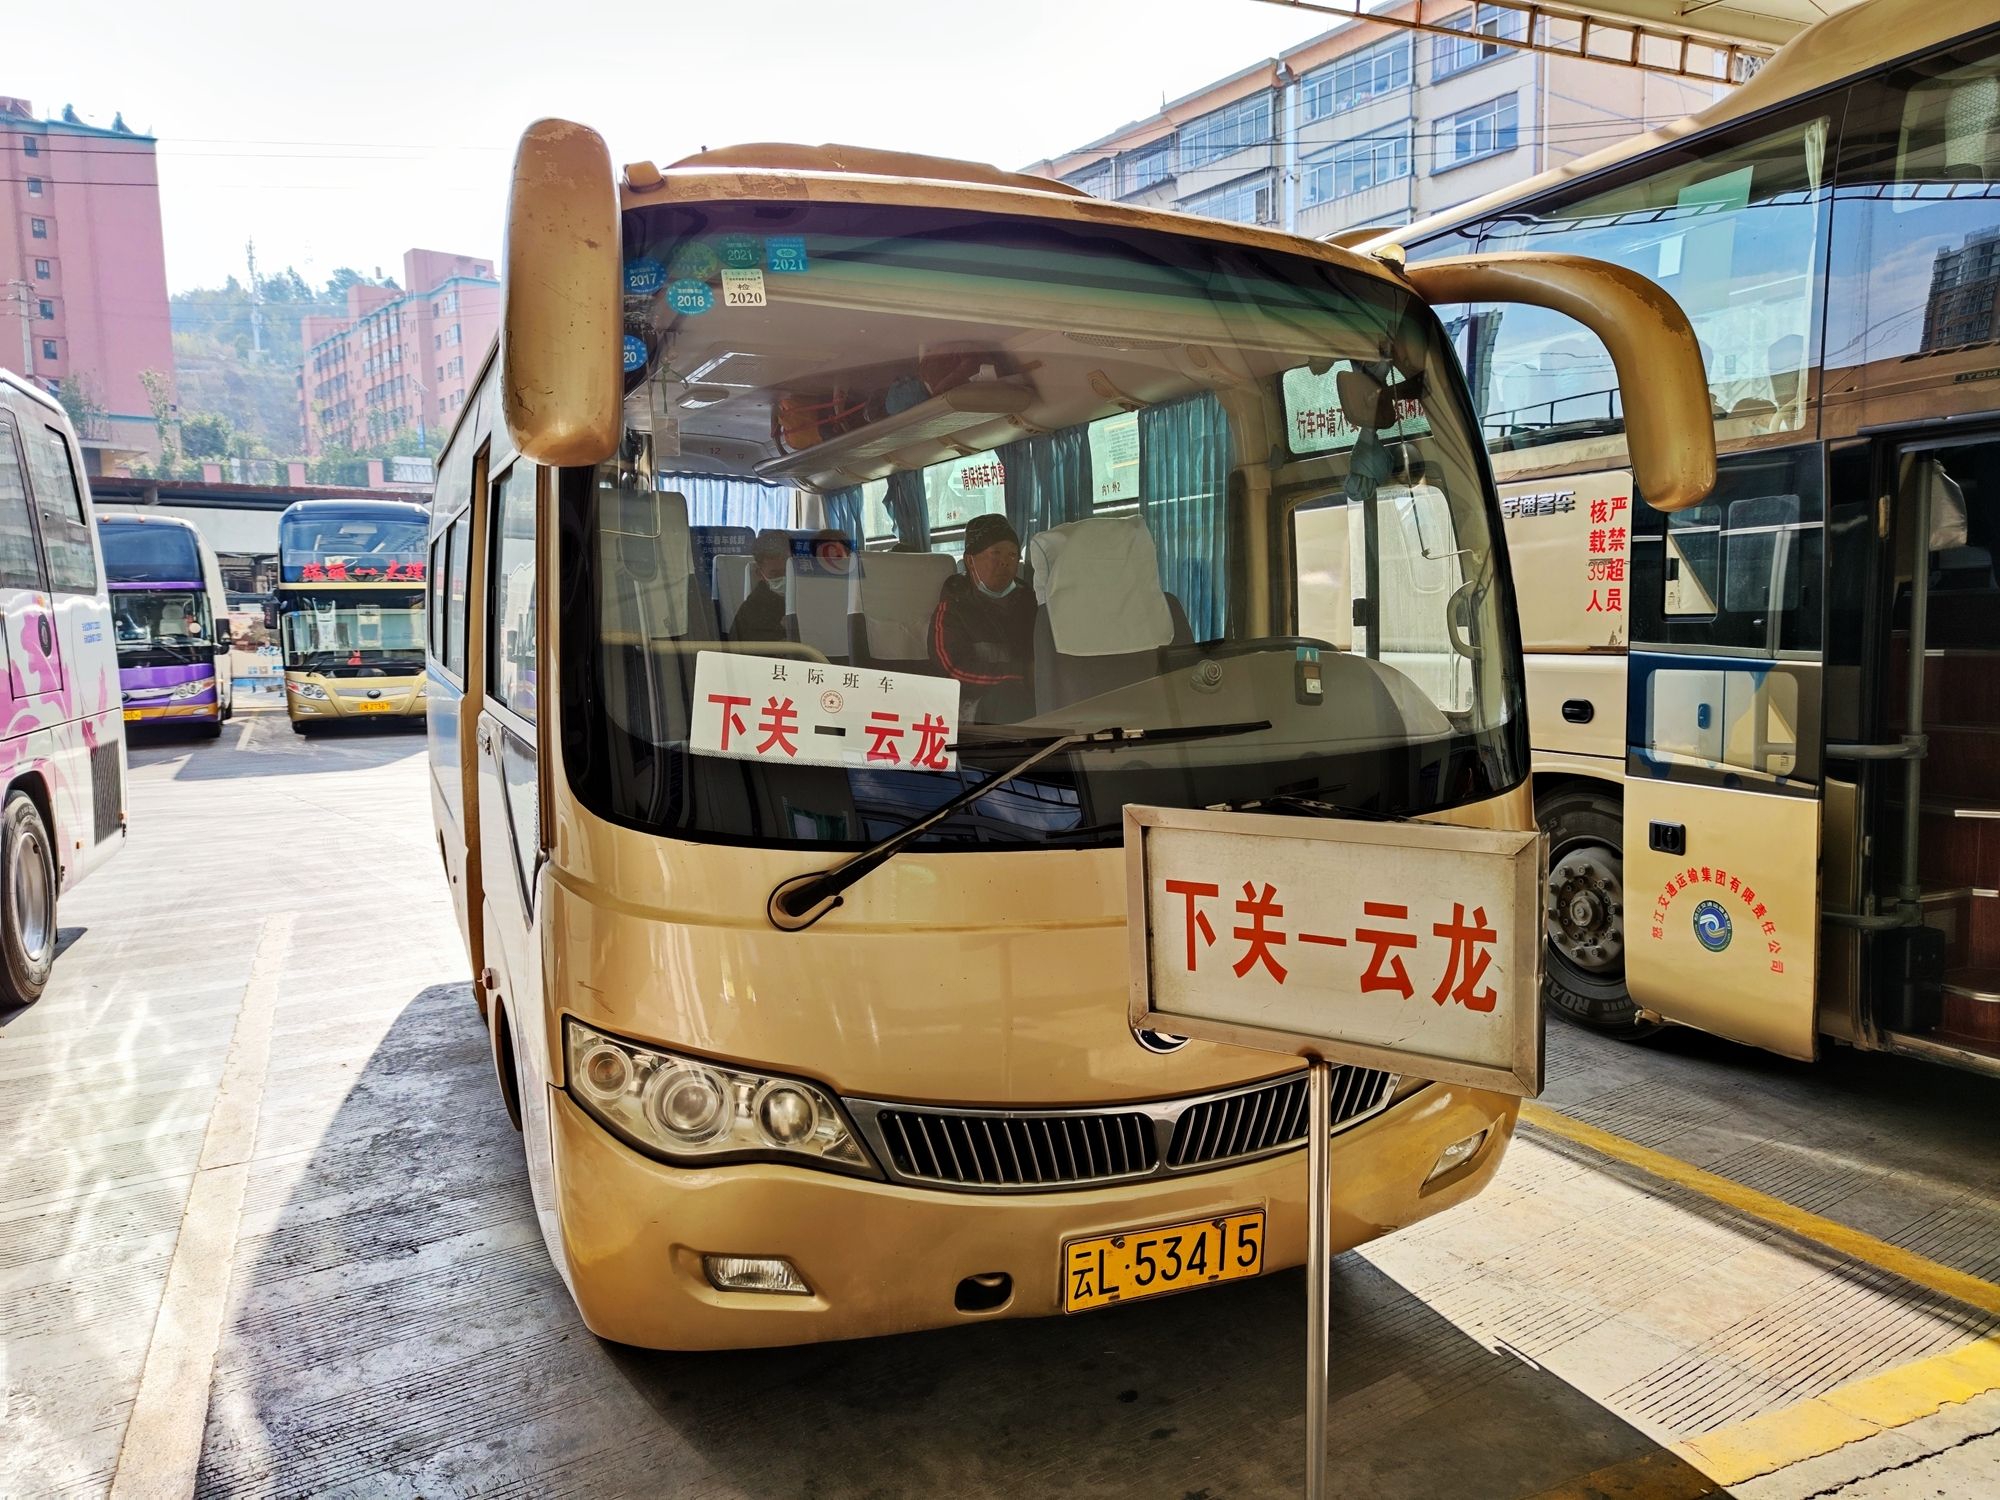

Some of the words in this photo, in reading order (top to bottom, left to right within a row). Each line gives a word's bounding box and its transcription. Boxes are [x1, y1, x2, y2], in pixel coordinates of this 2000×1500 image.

[727, 249, 753, 261] 2021
[772, 259, 803, 271] 2021
[630, 272, 657, 287] 2017
[677, 295, 705, 307] 2018
[728, 293, 763, 304] 2020
[1501, 490, 1576, 519] 宇通客车
[1605, 496, 1629, 613] 严禁超员
[771, 663, 895, 694] 县际班车
[1651, 866, 1785, 974] 怒江交通运输集团有限责任公司
